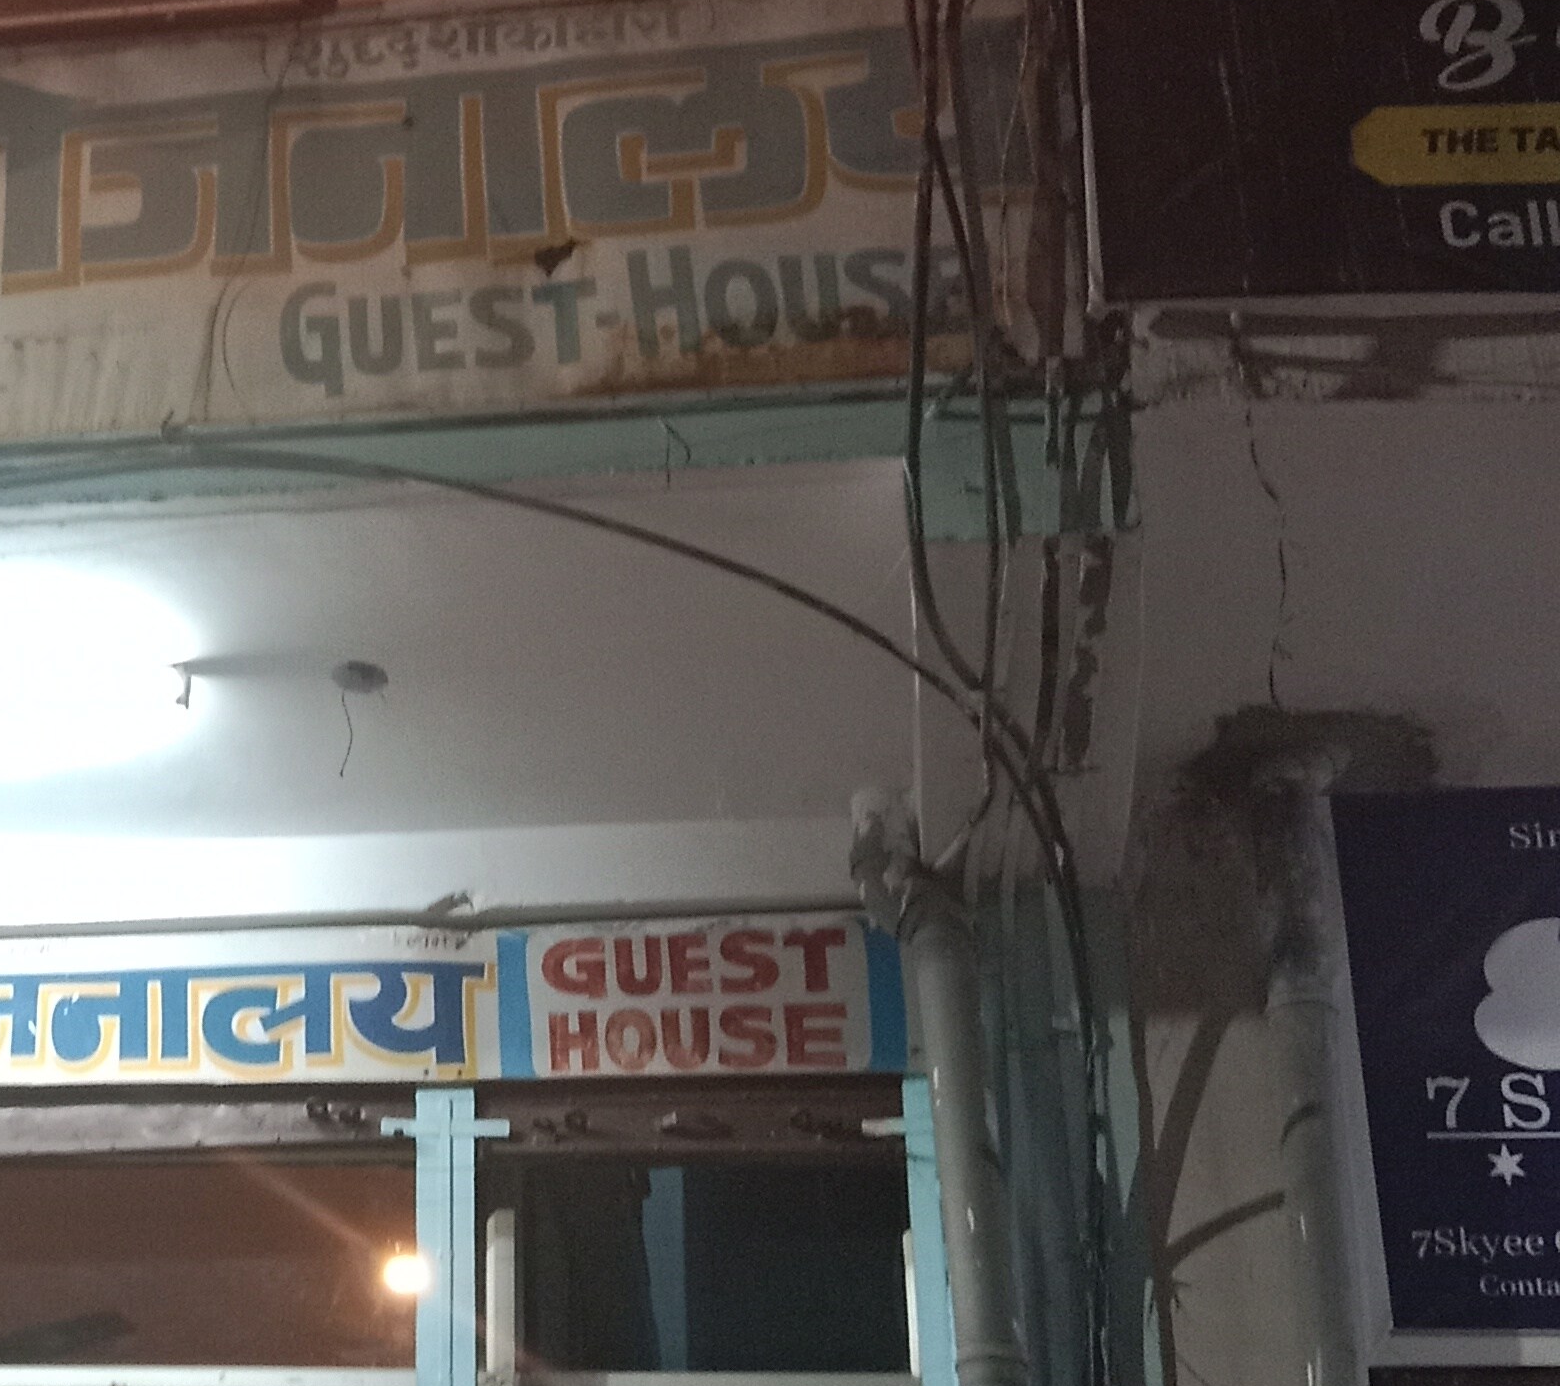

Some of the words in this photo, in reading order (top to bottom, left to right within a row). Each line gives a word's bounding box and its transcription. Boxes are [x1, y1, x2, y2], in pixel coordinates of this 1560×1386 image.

[1422, 126, 1499, 154] THE
[1439, 200, 1560, 249] Call
[541, 928, 847, 999] GUEST
[548, 1003, 847, 1073] HOUSE
[1411, 1225, 1545, 1264] 7Skyee
